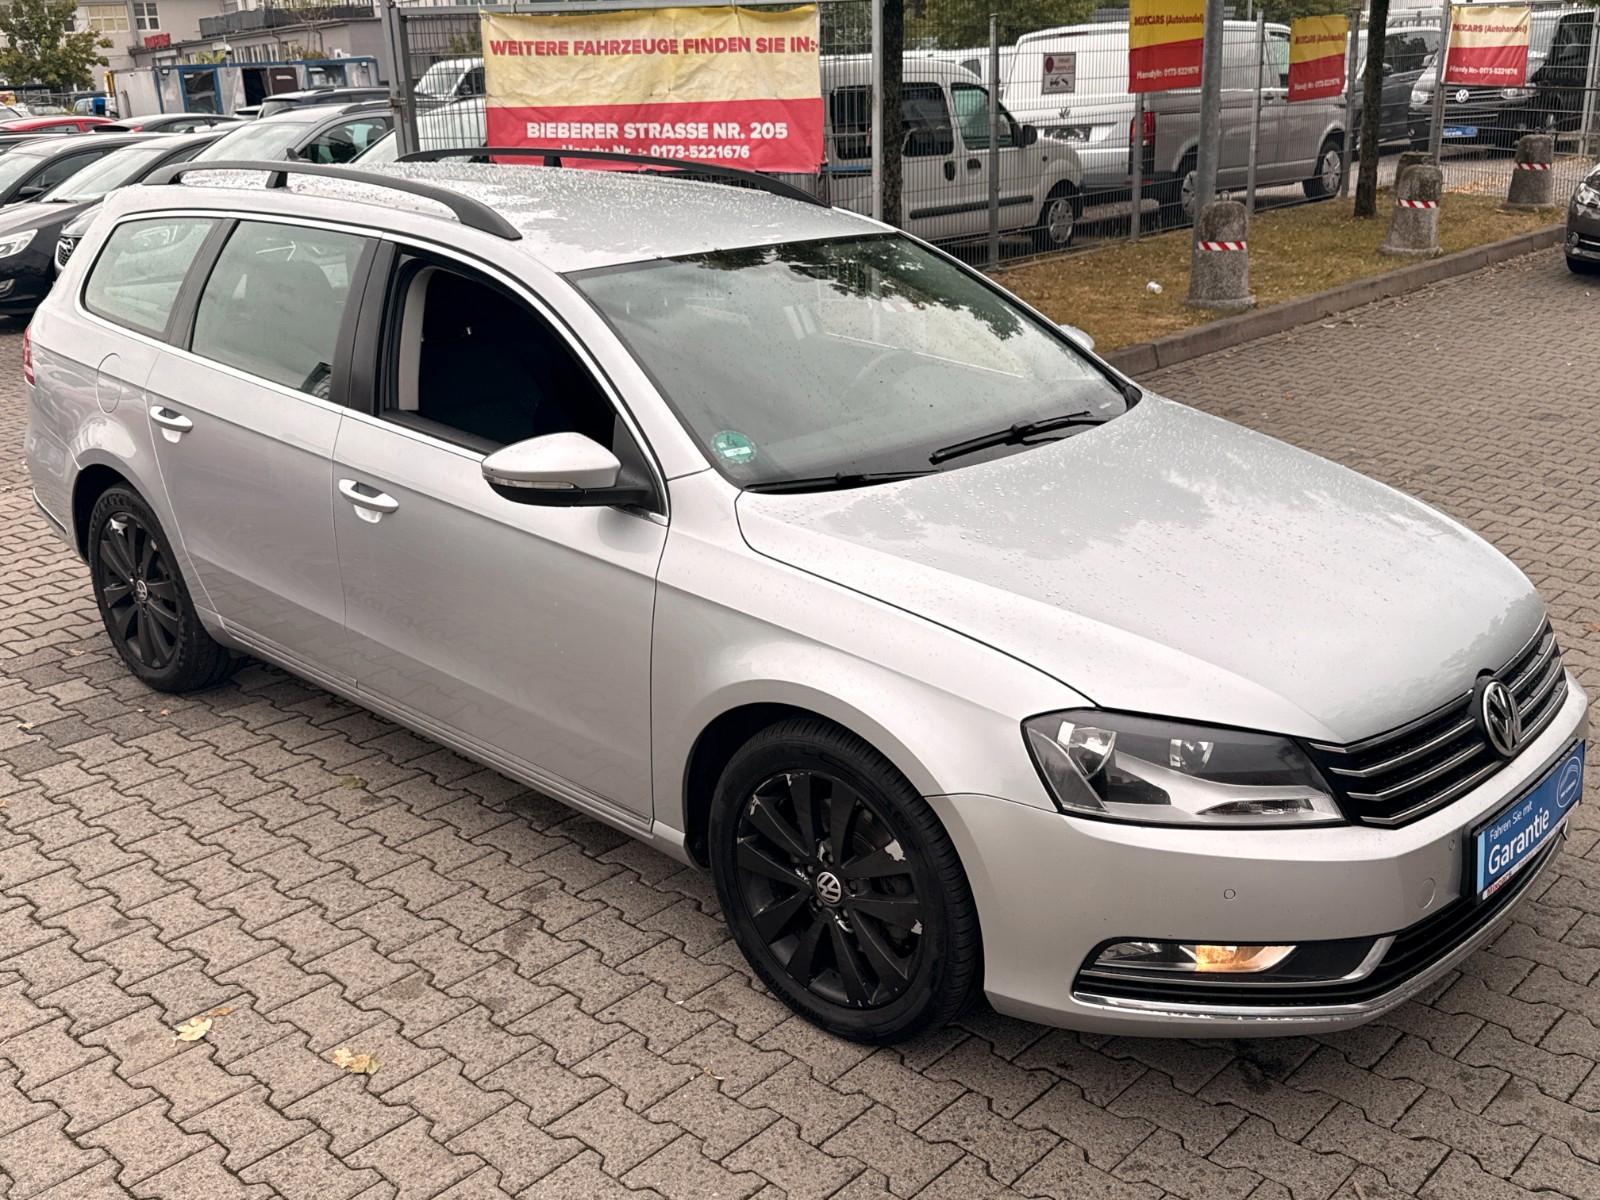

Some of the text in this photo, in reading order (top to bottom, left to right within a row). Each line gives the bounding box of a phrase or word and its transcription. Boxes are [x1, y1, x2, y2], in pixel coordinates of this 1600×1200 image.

[489, 40, 569, 57] WEITERE
[573, 39, 680, 57] FAHRZEUGE
[683, 37, 751, 55] FINDEN
[755, 37, 786, 53] SIE
[526, 122, 788, 140] BIEBERER STRASSE NR. 205
[650, 145, 750, 159] 0173-5221676
[1488, 807, 1550, 875] Garantie
